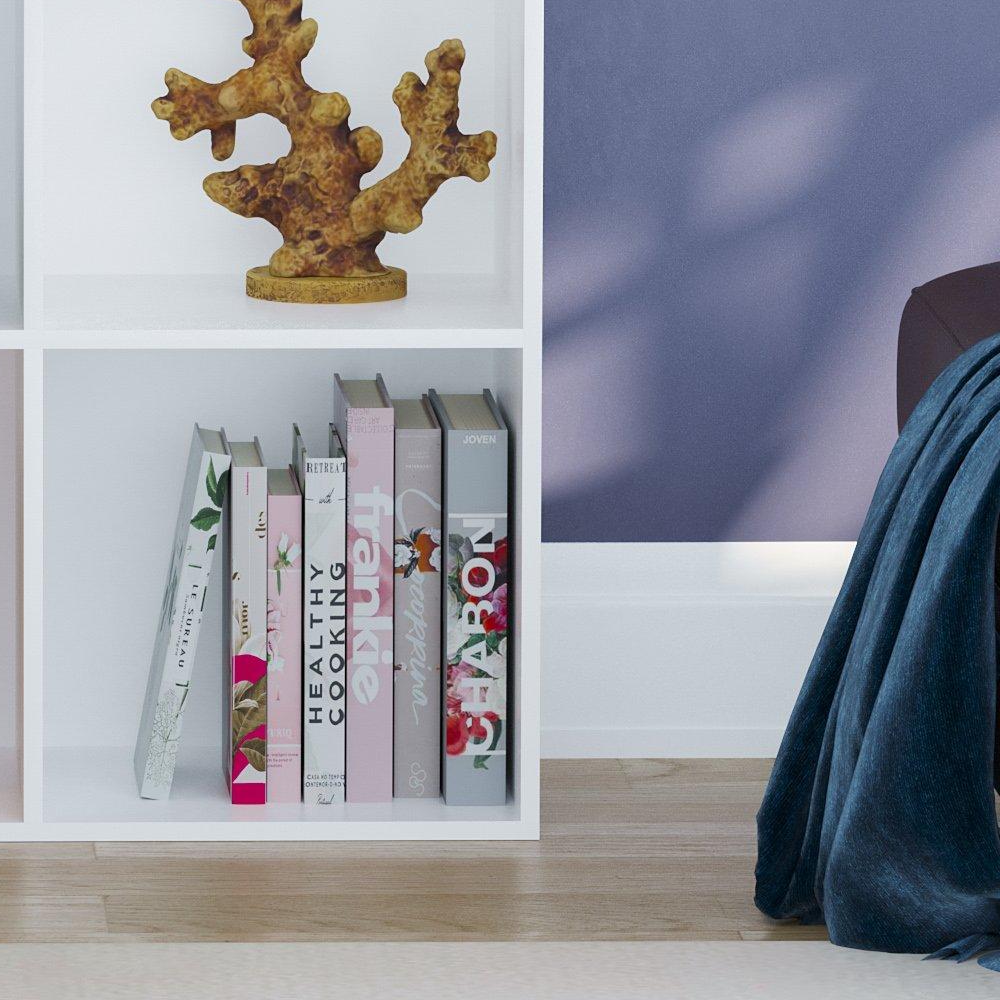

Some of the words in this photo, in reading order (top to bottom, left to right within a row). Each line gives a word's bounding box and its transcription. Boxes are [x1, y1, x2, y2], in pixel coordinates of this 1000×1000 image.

[307, 463, 346, 473] RETREAT
[463, 435, 496, 444] JOVEN
[178, 608, 194, 668] SUREAU
[191, 584, 199, 599] LE
[309, 564, 323, 724] HEALTHY
[329, 562, 345, 726] COOKING
[352, 486, 393, 705] frankie
[461, 518, 496, 750] CHABON
